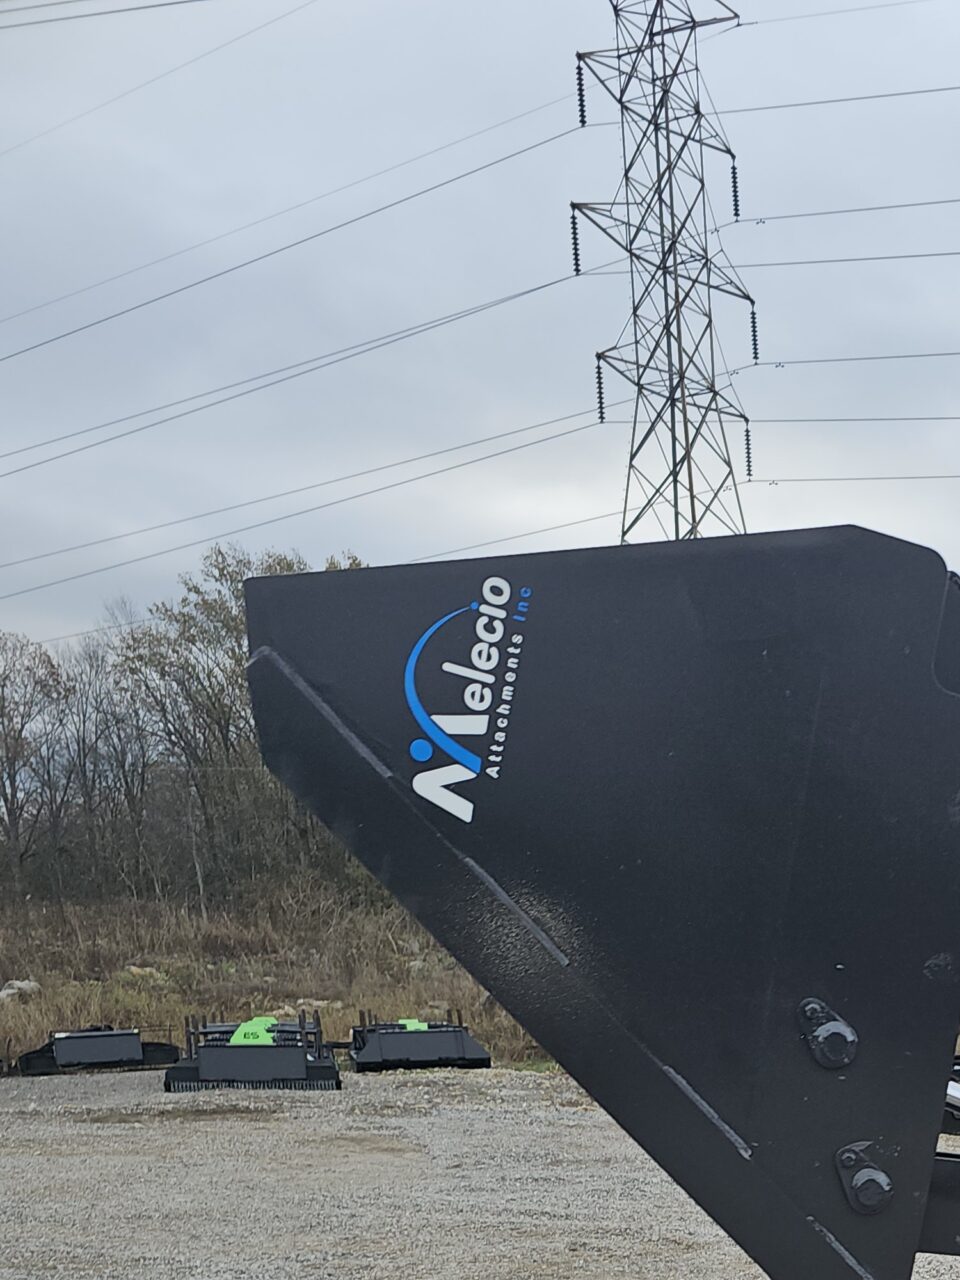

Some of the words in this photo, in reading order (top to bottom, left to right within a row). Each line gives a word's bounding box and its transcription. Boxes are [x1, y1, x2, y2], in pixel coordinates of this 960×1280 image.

[411, 576, 511, 823] Melecio
[485, 633, 523, 779] Attachments
[512, 586, 532, 622] Inc
